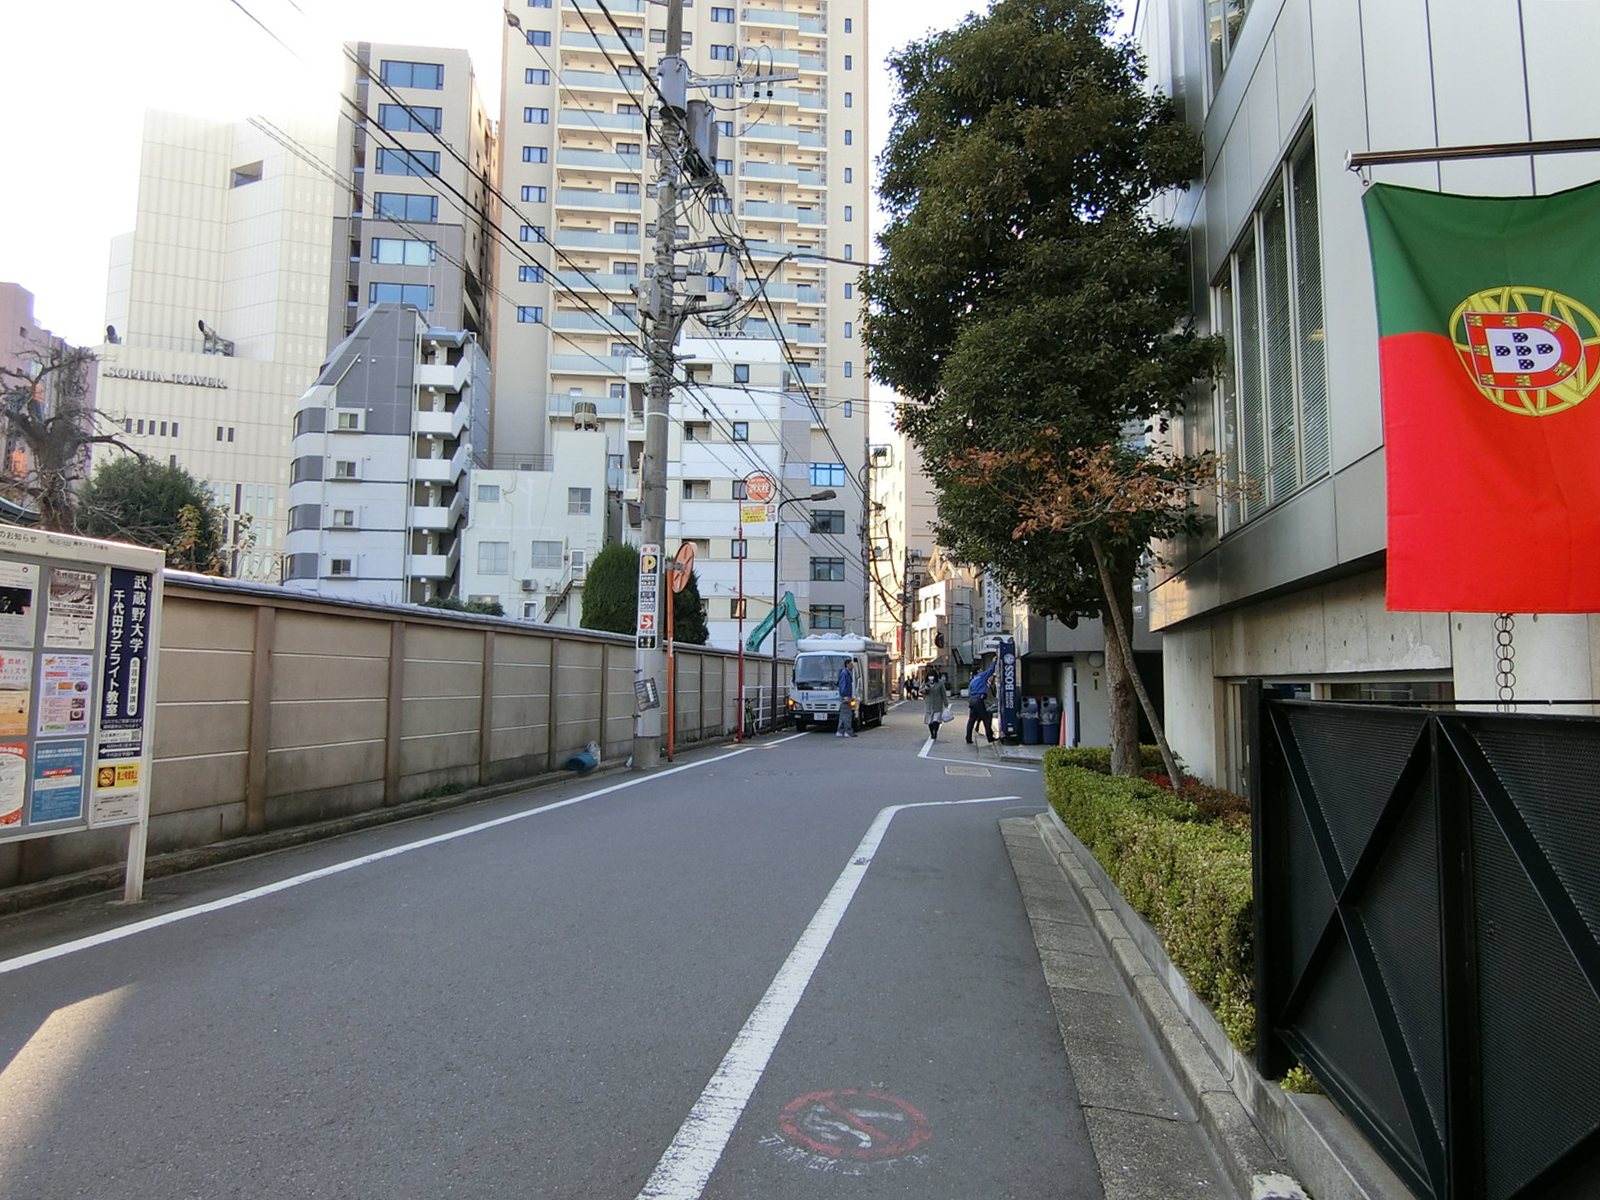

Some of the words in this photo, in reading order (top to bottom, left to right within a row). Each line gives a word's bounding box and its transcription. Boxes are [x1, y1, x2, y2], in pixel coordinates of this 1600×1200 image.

[107, 367, 165, 381] SOPHIA
[171, 373, 225, 388] TOWER
[129, 575, 148, 653] 武蔵野大学
[105, 589, 126, 717] 千代田サテライト教室
[1005, 665, 1014, 691] BOSS
